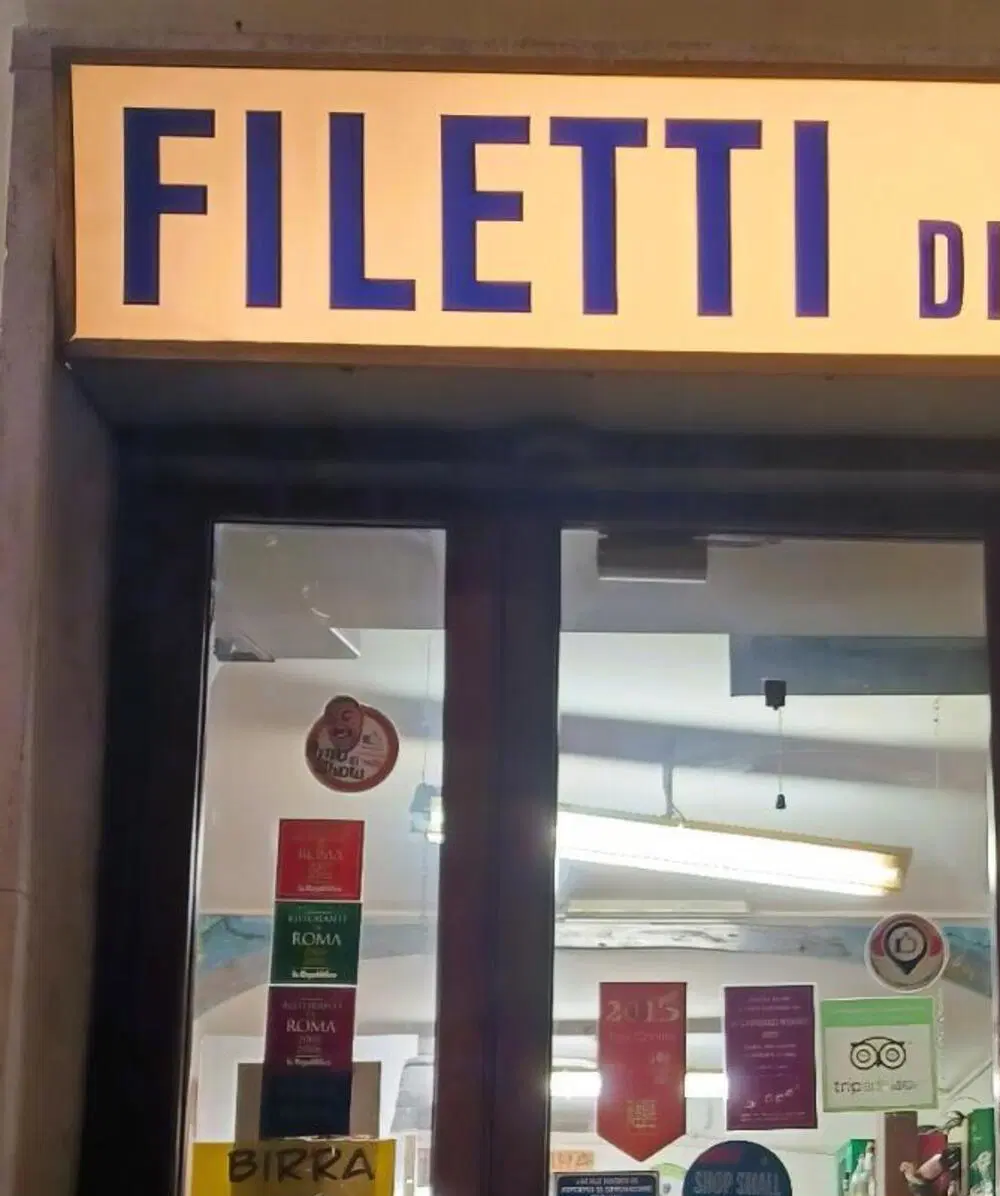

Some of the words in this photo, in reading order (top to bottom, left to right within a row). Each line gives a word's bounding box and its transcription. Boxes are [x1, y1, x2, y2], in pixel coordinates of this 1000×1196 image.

[123, 107, 829, 317] FILETTI
[292, 931, 341, 946] ROMA
[606, 992, 680, 1022] 2015
[286, 1019, 336, 1033] ROMA
[228, 1148, 376, 1183] BIRRA
[693, 1170, 734, 1196] SHOP
